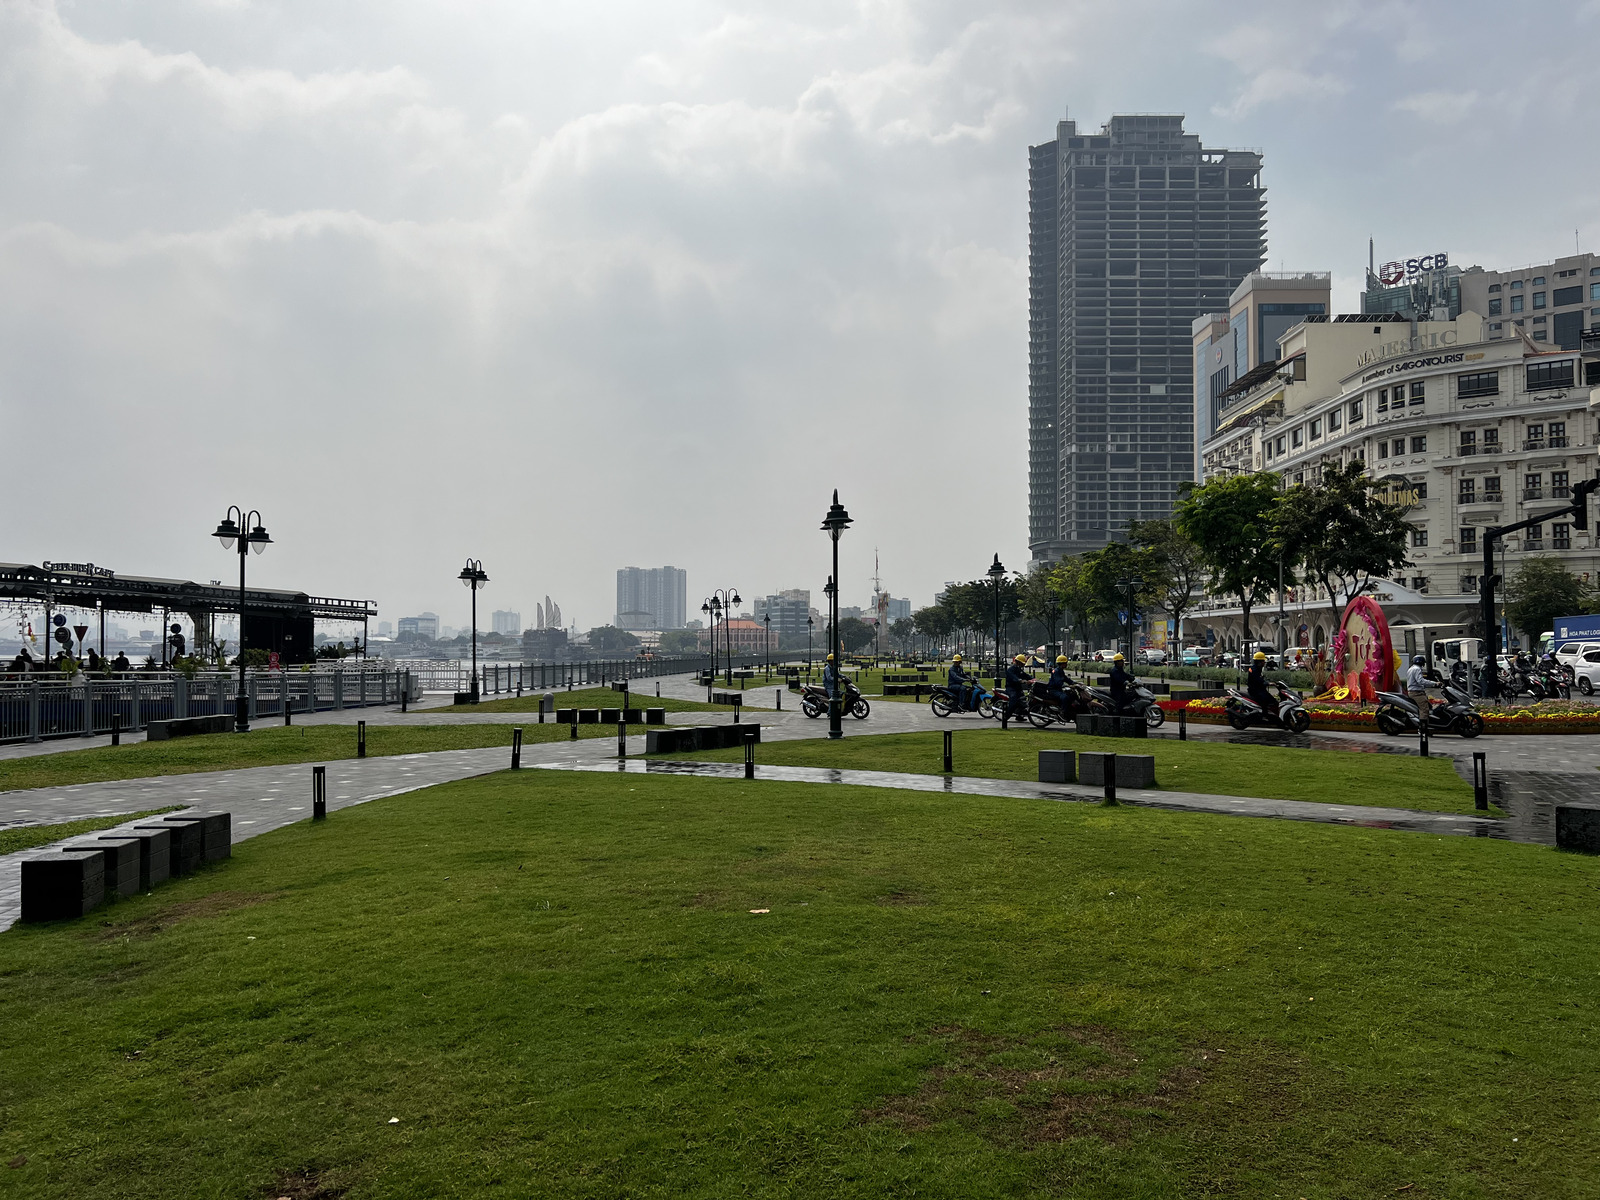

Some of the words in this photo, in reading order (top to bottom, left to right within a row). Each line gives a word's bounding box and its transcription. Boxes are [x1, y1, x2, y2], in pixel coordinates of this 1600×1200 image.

[1406, 253, 1448, 274] SCB
[1357, 330, 1457, 368] MAJESTIC
[1386, 364, 1394, 375] of
[1395, 353, 1464, 372] SAIGONTOURIST
